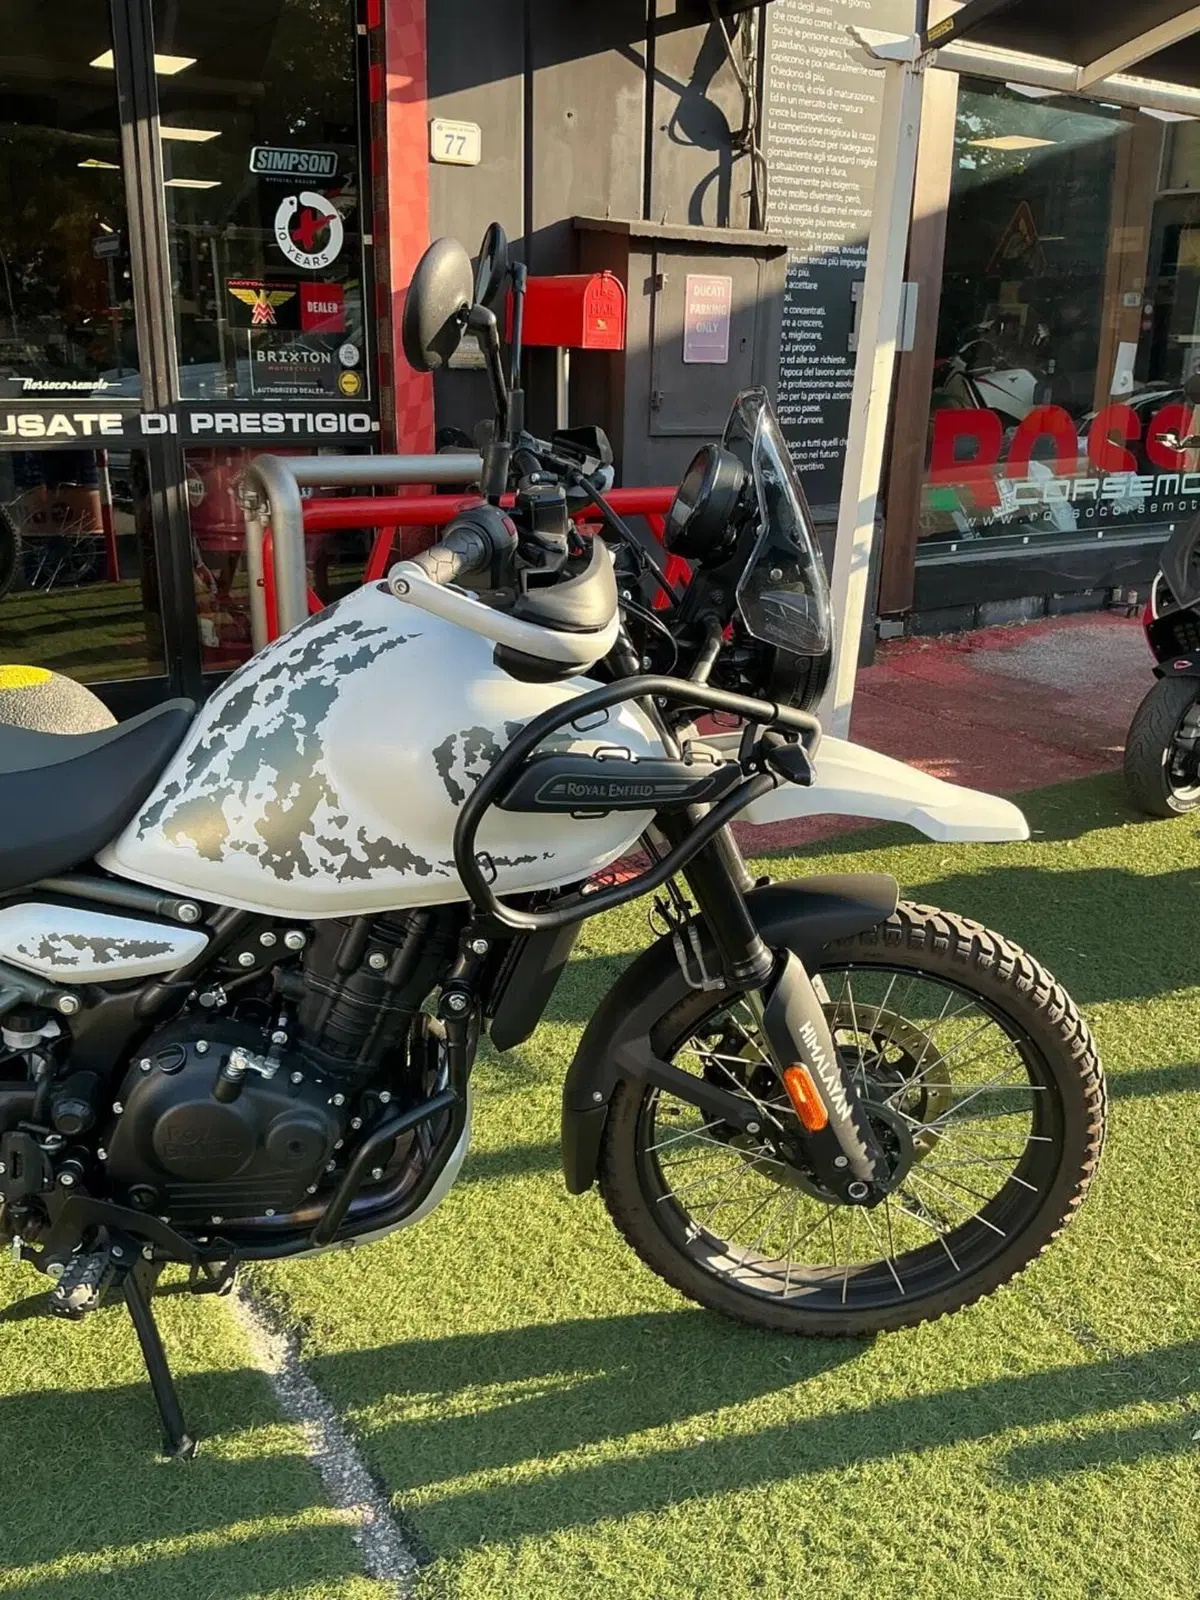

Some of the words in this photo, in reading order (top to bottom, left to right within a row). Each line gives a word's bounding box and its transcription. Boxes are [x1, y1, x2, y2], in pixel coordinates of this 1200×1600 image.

[798, 1, 815, 14] degli
[773, 11, 785, 19] che
[814, 19, 832, 29] come
[771, 79, 785, 89] Non
[770, 92, 779, 102] Ed
[445, 134, 466, 156] 77
[257, 150, 331, 173] SIMPSON
[287, 246, 328, 266] YEARS
[694, 285, 725, 297] DUCATI
[307, 301, 338, 313] DEALER
[690, 304, 728, 316] PARKING
[696, 321, 719, 333] ONLY
[257, 350, 331, 363] BRIXTON
[256, 387, 299, 395] AUTHORIZED
[299, 387, 325, 395] DEALER
[141, 414, 176, 434] DI
[566, 782, 605, 797] ROYAL
[608, 782, 653, 798] ENFIELD
[799, 1020, 853, 1121] HIMALAYAN
